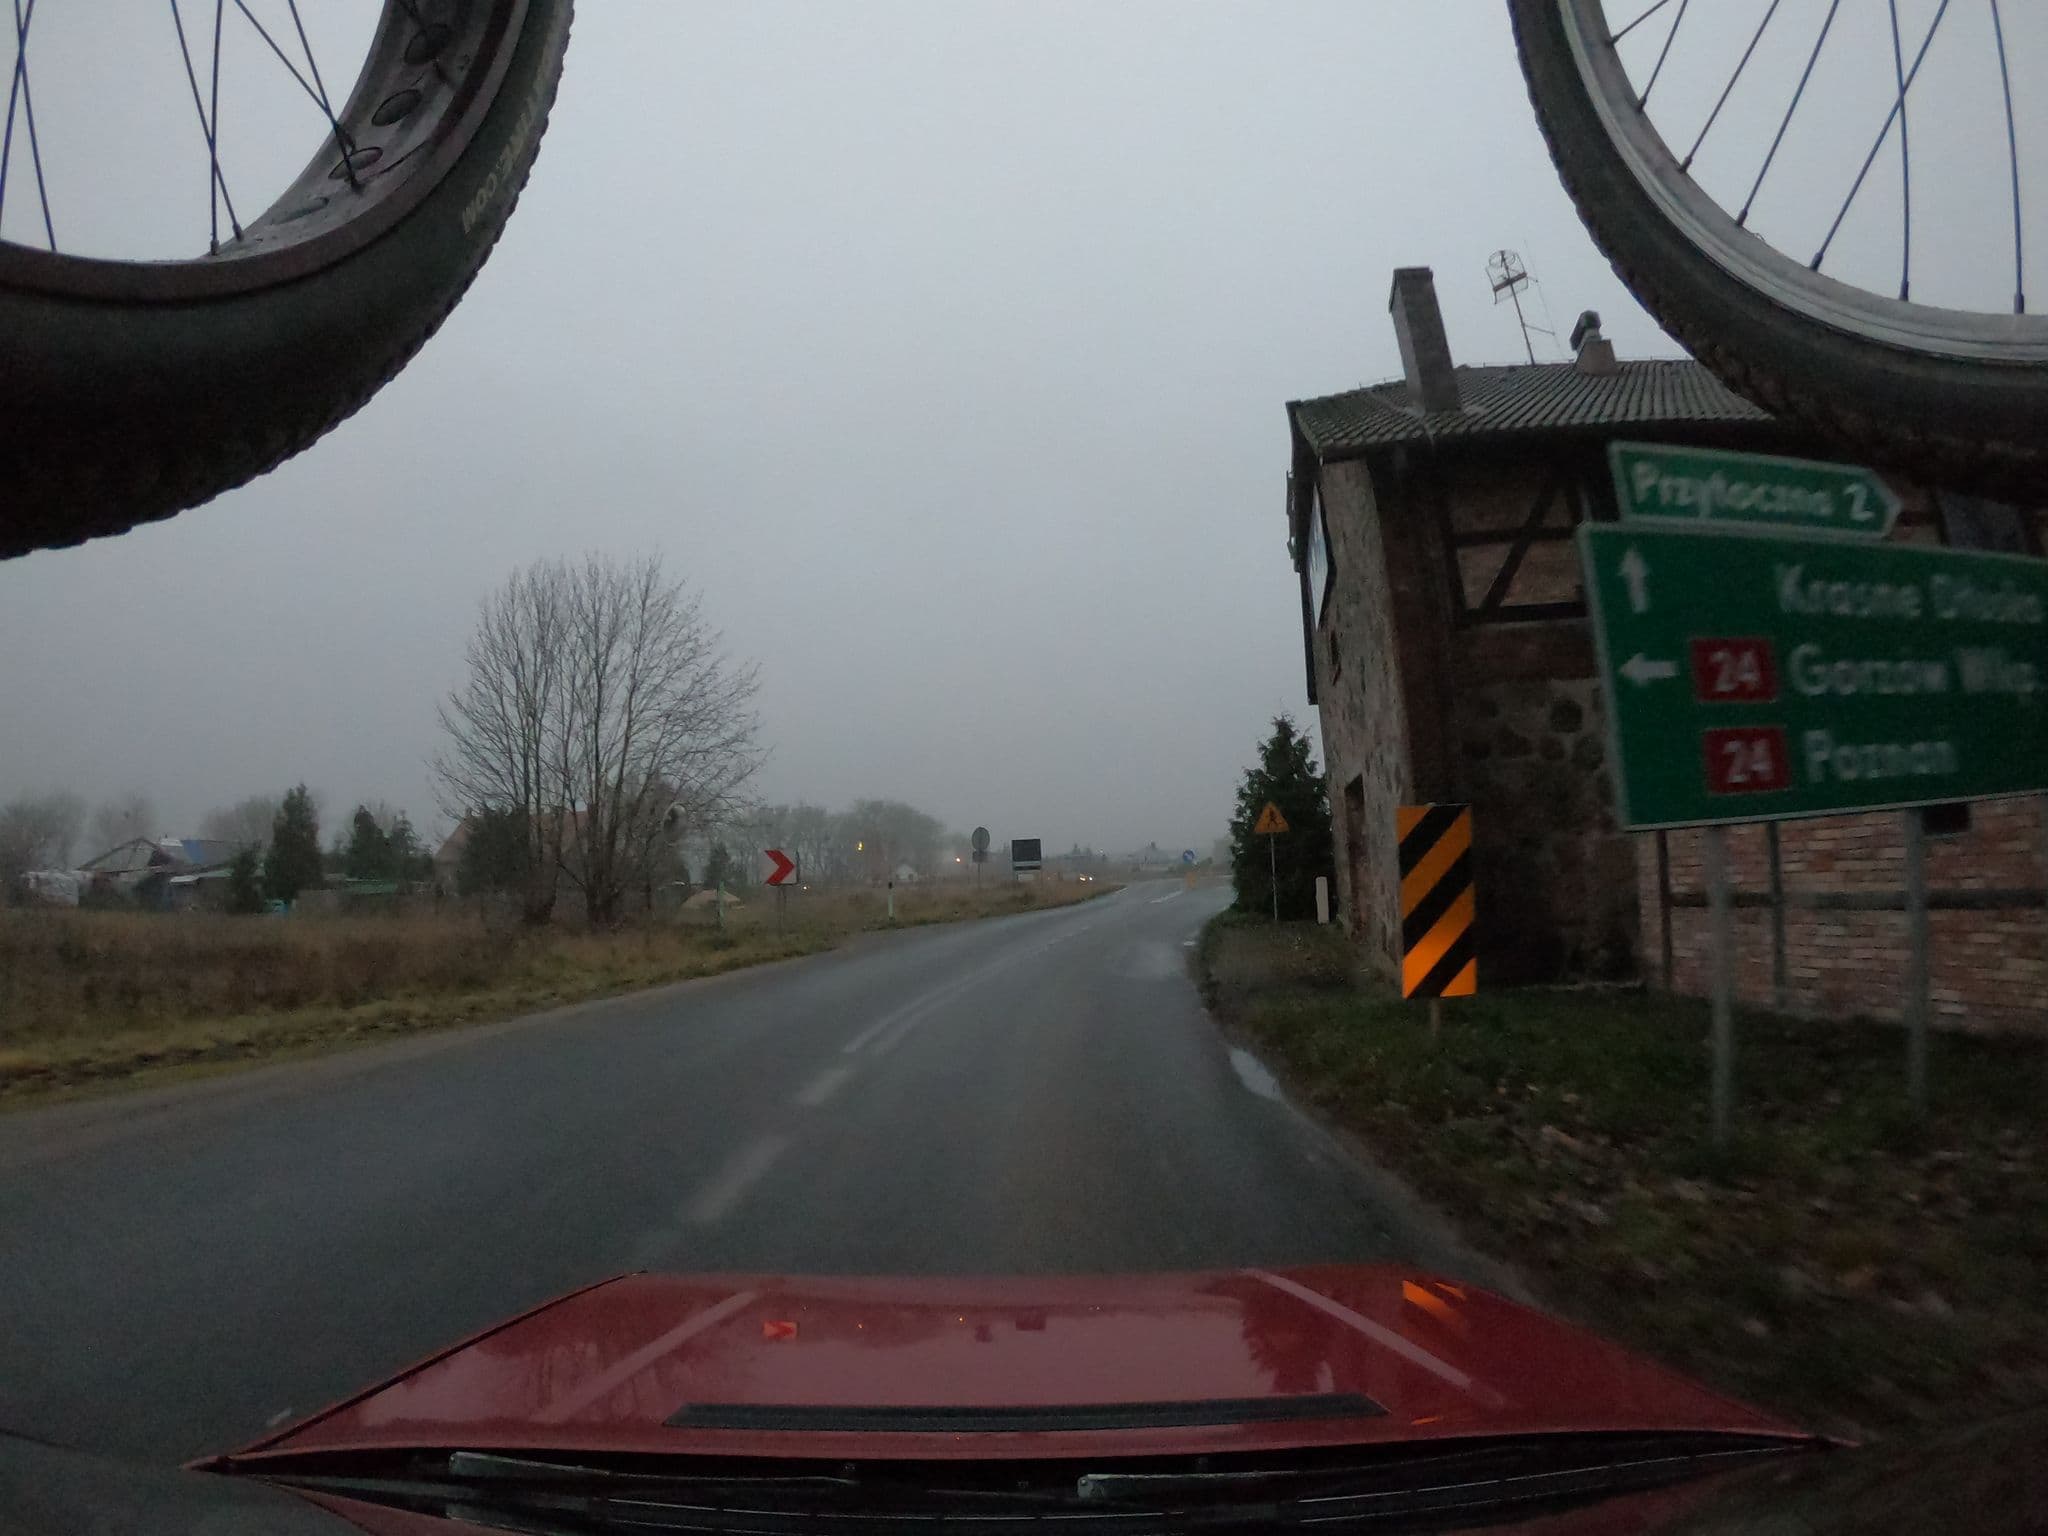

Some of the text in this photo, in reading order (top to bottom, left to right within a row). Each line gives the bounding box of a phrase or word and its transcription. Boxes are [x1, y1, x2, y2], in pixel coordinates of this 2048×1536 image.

[1843, 481, 1875, 521] 2
[1708, 647, 1761, 693] 24
[1721, 738, 1775, 784] 24
